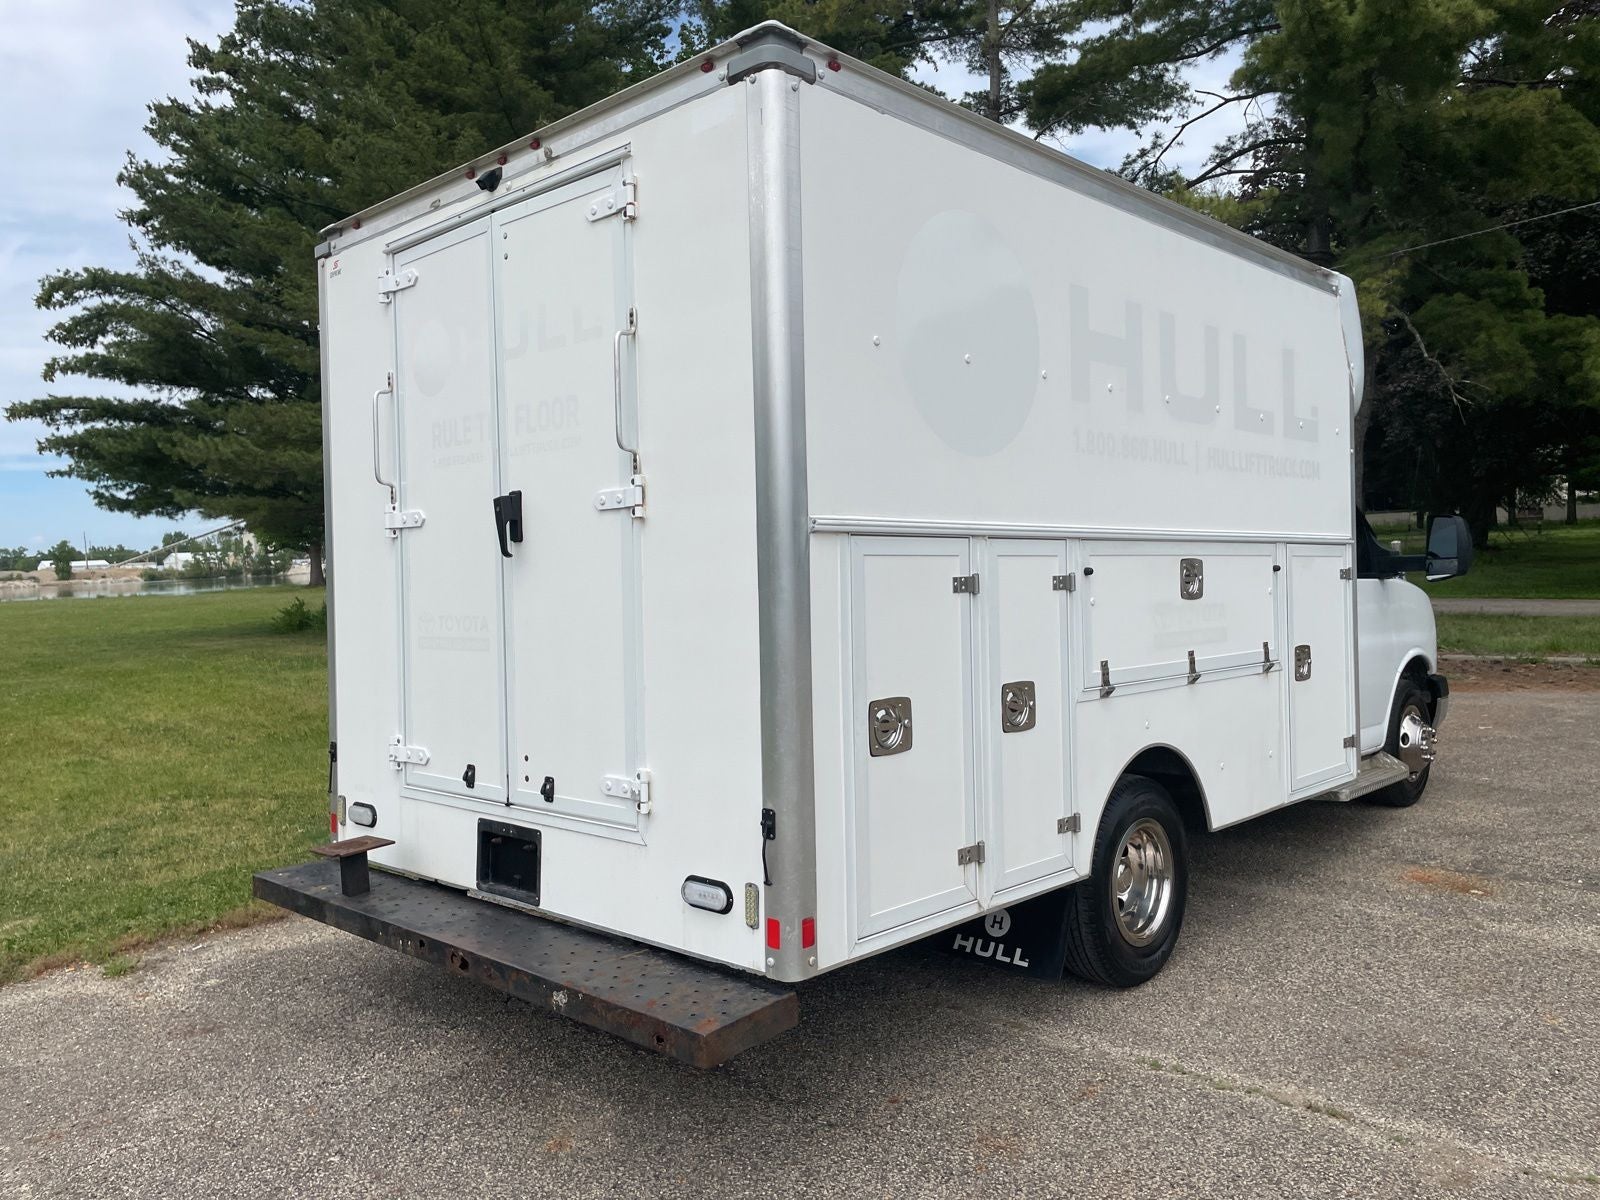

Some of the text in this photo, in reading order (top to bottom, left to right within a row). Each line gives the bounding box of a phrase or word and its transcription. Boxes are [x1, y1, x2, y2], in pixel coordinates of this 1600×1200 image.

[1069, 282, 1320, 443] HULL
[432, 415, 473, 450] RULE
[514, 394, 580, 436] FLOOR
[438, 615, 489, 633] TOYOTA
[990, 914, 1004, 930] H
[952, 933, 1030, 968] HULL
